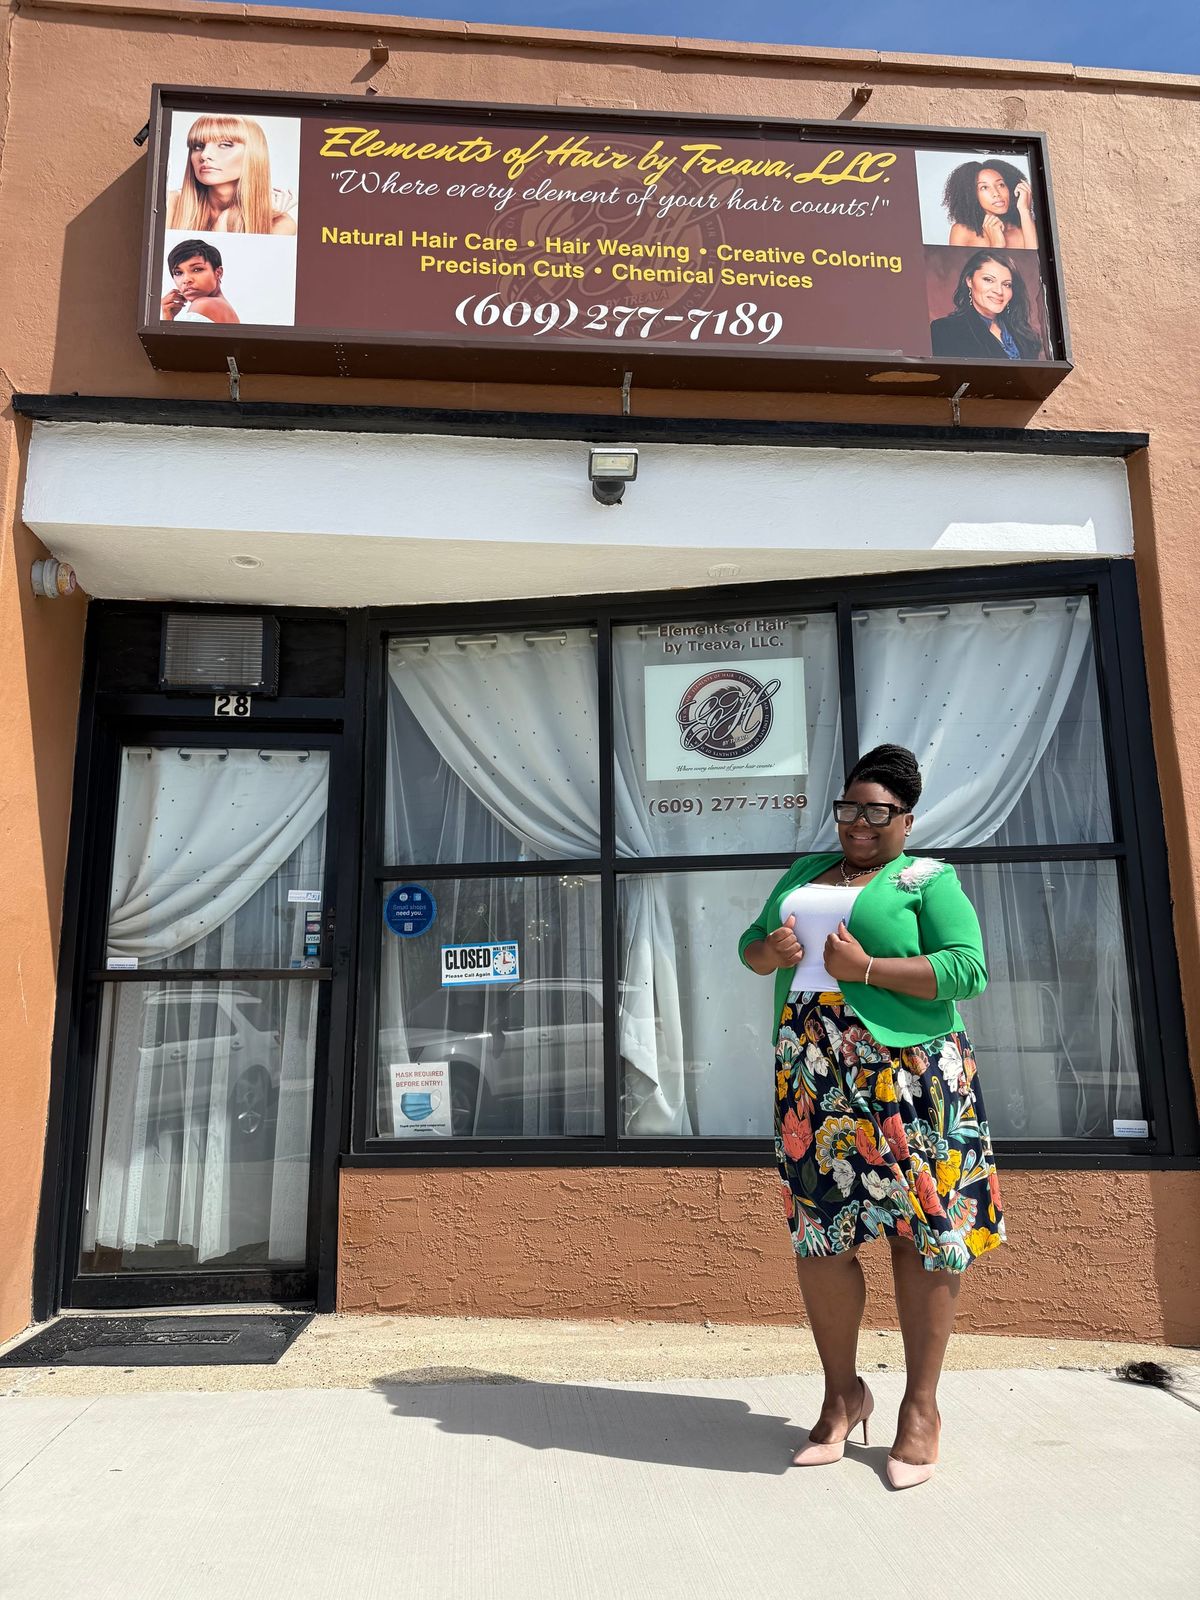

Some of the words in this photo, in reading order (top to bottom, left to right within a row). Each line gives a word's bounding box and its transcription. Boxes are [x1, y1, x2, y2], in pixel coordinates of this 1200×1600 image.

[319, 126, 501, 163] Elements
[503, 135, 549, 181] of
[545, 136, 636, 170] Hair
[637, 140, 678, 187] by
[793, 150, 897, 185] LLC.
[331, 169, 440, 196] "Where
[446, 182, 516, 211] every
[522, 178, 620, 204] element
[626, 184, 658, 217] of
[656, 193, 720, 219] your
[727, 188, 785, 213] hair
[790, 195, 890, 218] counts!"
[321, 226, 403, 247] Natural
[411, 231, 458, 249] Hair
[464, 233, 517, 251] Care
[545, 236, 591, 255] Hair
[597, 239, 690, 263] Weaving
[716, 244, 806, 264] Creative
[812, 248, 902, 273] Coloring
[420, 255, 526, 276] Precision
[533, 260, 585, 279] Cuts
[611, 263, 714, 284] Chemical
[721, 268, 814, 289] Services
[455, 292, 579, 336] (609)
[583, 302, 783, 345] 277-7189
[658, 623, 730, 637] Elements
[734, 620, 751, 633] of
[754, 619, 789, 632] Hair
[663, 641, 682, 655] by
[686, 640, 745, 652] Treava,
[750, 635, 784, 648] LLC.
[217, 695, 249, 716] 28
[648, 798, 703, 816] (609)
[711, 793, 809, 812] 277-7189
[445, 948, 491, 970] CLOSED
